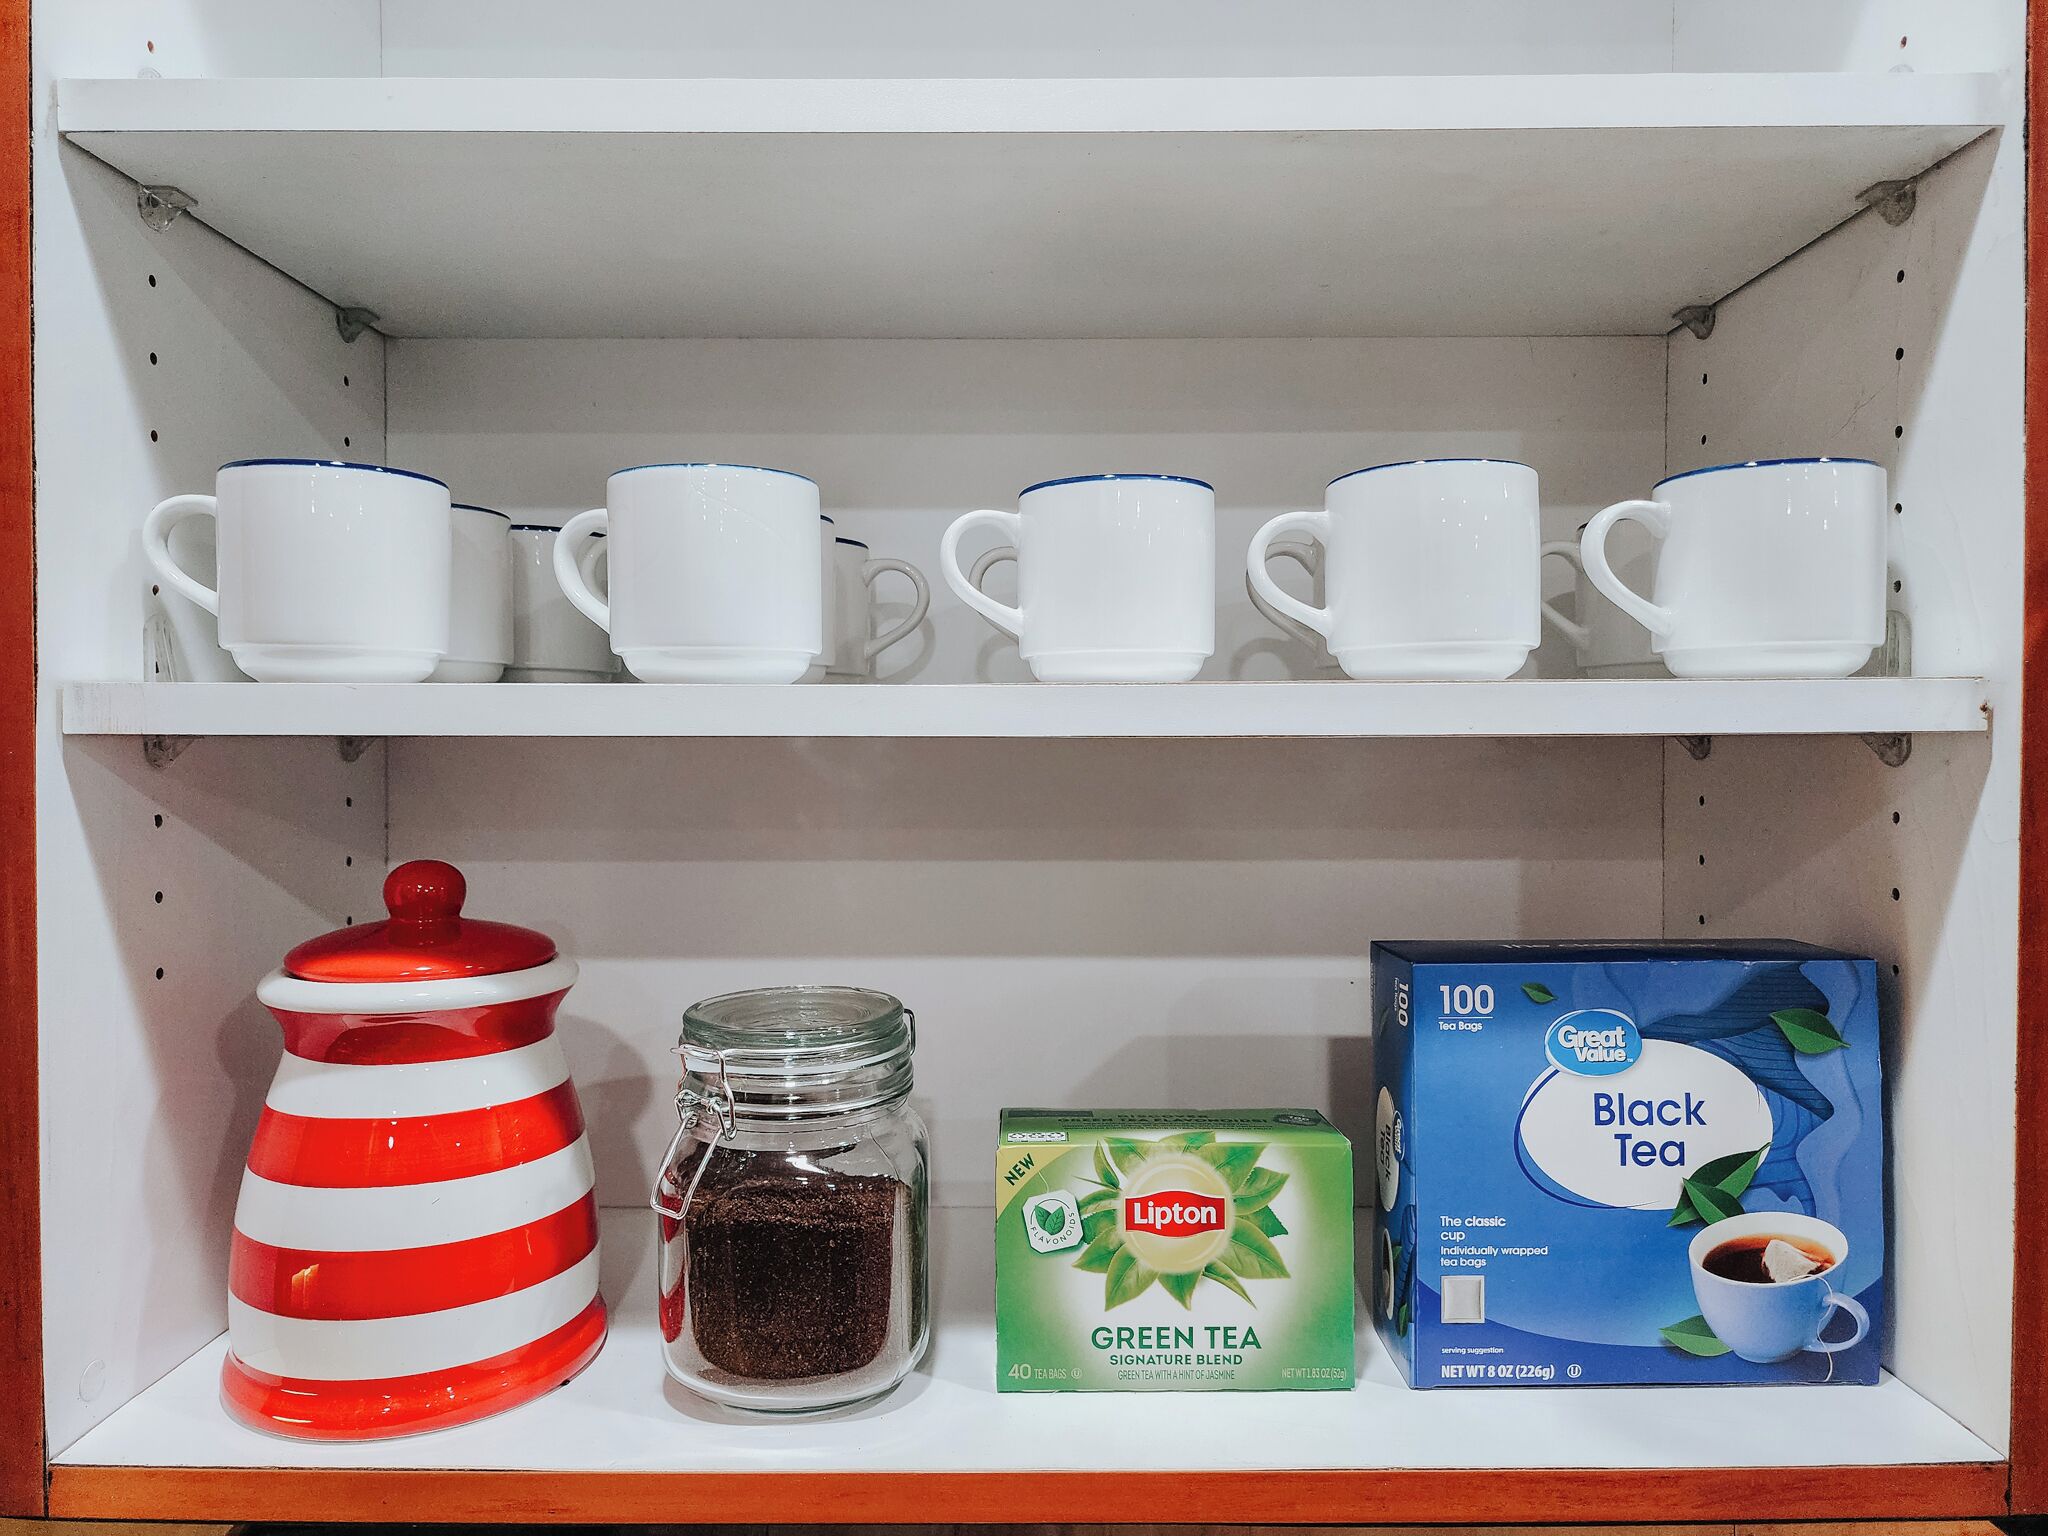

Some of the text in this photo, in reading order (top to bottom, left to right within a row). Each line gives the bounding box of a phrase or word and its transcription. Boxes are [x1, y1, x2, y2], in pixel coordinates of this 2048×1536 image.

[1399, 983, 1408, 1027] 100
[1438, 984, 1495, 1015] 100
[1438, 1021, 1483, 1034] Tea Bags
[1558, 1025, 1627, 1048] Great
[1574, 1046, 1627, 1062] Value
[1593, 1093, 1707, 1126] Black
[1614, 1133, 1685, 1166] Tea
[1004, 1153, 1034, 1186] NEW
[1133, 1202, 1217, 1229] Lipton
[1440, 1216, 1506, 1227] The classic
[1030, 1212, 1076, 1245] FLAVONOIDS
[1440, 1231, 1465, 1242] cup
[1440, 1246, 1548, 1257] Individually wrapped
[1440, 1257, 1486, 1268] tea bags
[1091, 1326, 1262, 1350] GREEN TEA
[1441, 1347, 1504, 1355] serving suggestion
[1110, 1354, 1243, 1366] SIGNATURE BLEND
[1008, 1363, 1067, 1379] 40 TEA BAGS
[1118, 1369, 1236, 1380] GREEN TEA WITH A HINT OF JASMINE
[1281, 1368, 1294, 1379] NET
[1295, 1368, 1307, 1379] WT
[1320, 1368, 1331, 1379] OZ
[1331, 1367, 1347, 1381] (52g)
[1441, 1364, 1555, 1380] NET WT 8 OZ (226g)
